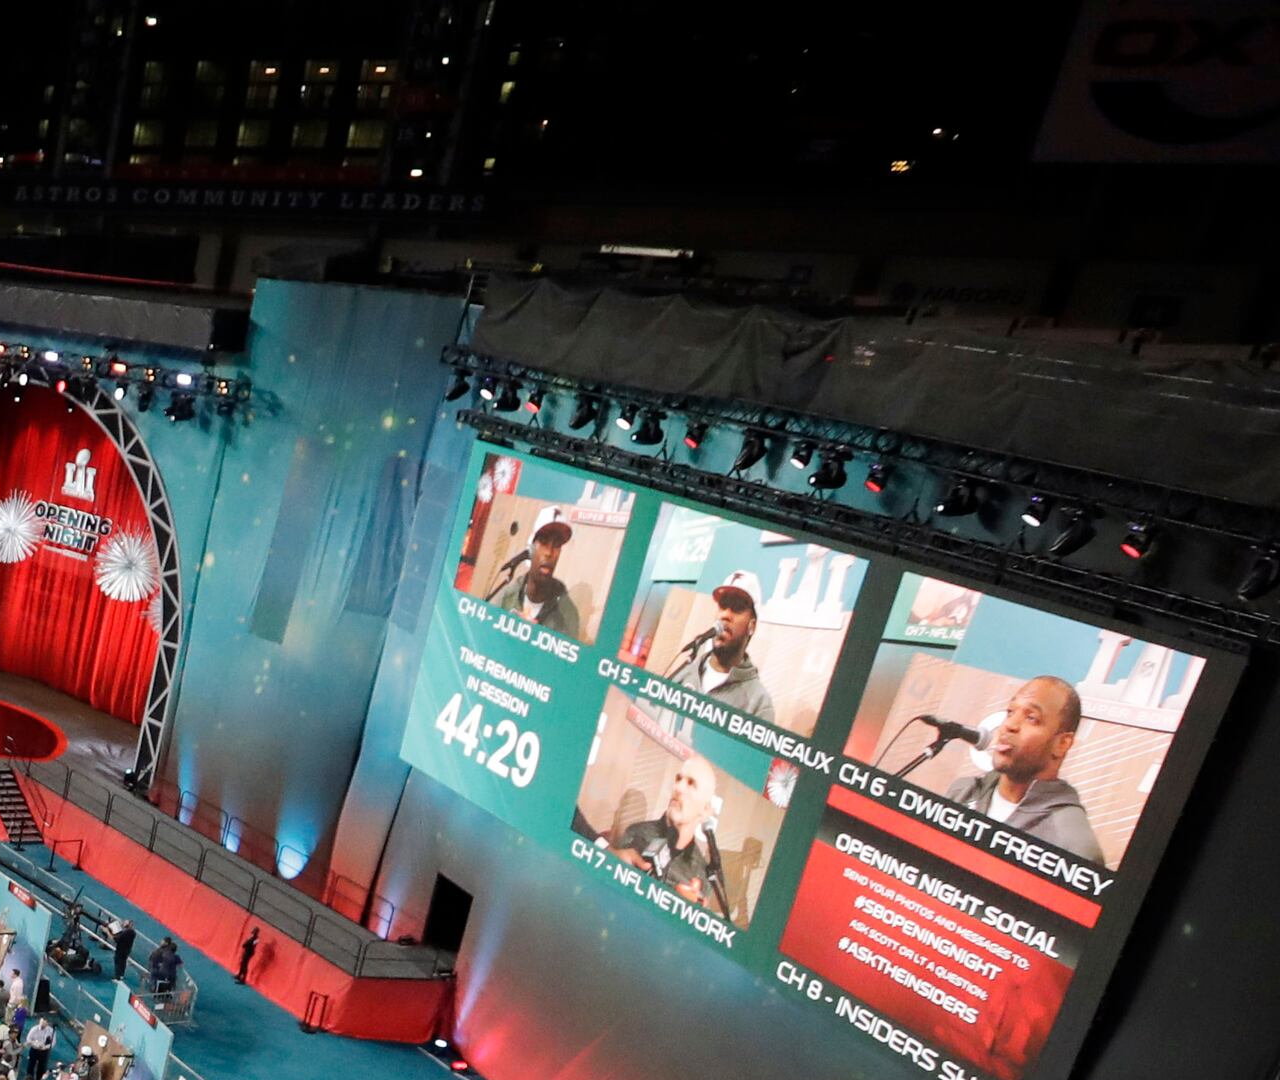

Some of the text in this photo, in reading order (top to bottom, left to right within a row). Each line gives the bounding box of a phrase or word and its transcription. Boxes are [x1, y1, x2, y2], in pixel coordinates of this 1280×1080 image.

[15, 185, 487, 212] ASTROS COMMUNITY LEADERS
[34, 499, 113, 536] OPENING
[42, 521, 99, 553] NIGHT
[458, 598, 476, 616] CH
[476, 606, 487, 622] 4
[493, 614, 531, 642] JULIO
[531, 631, 580, 663] JONES
[460, 646, 551, 703] TIME REMAINING
[466, 675, 529, 717] IN SESSION
[598, 658, 619, 680] CH
[620, 668, 632, 684] 5
[639, 677, 727, 727] JONATHAN
[727, 715, 834, 774] BABINEAUX
[435, 693, 540, 788] 44:29
[839, 763, 870, 790] CH
[870, 779, 887, 797] 6
[899, 789, 992, 842] DWIGHT
[989, 831, 1114, 896] FREENEY
[571, 839, 594, 863] CH
[594, 852, 606, 868] 7
[613, 863, 645, 895] NFL
[646, 883, 737, 948] NETWORK
[835, 833, 1060, 958] OPENING NIGHT SOCIAL
[842, 867, 868, 887] SEND
[869, 881, 895, 900] YOUR
[895, 894, 935, 921] PHOTOS
[934, 914, 958, 933] AND
[956, 926, 1013, 961] MESSAGES
[837, 936, 980, 1024] #ASKTHEINSIDERS
[849, 919, 870, 937] ASK
[868, 929, 900, 951] SCOTT
[897, 944, 914, 960] OR
[853, 895, 1002, 981] #SBOPENINGNIGHT
[777, 961, 807, 991] CH
[806, 979, 823, 1000] 8
[835, 996, 939, 1072] INSIDERS
